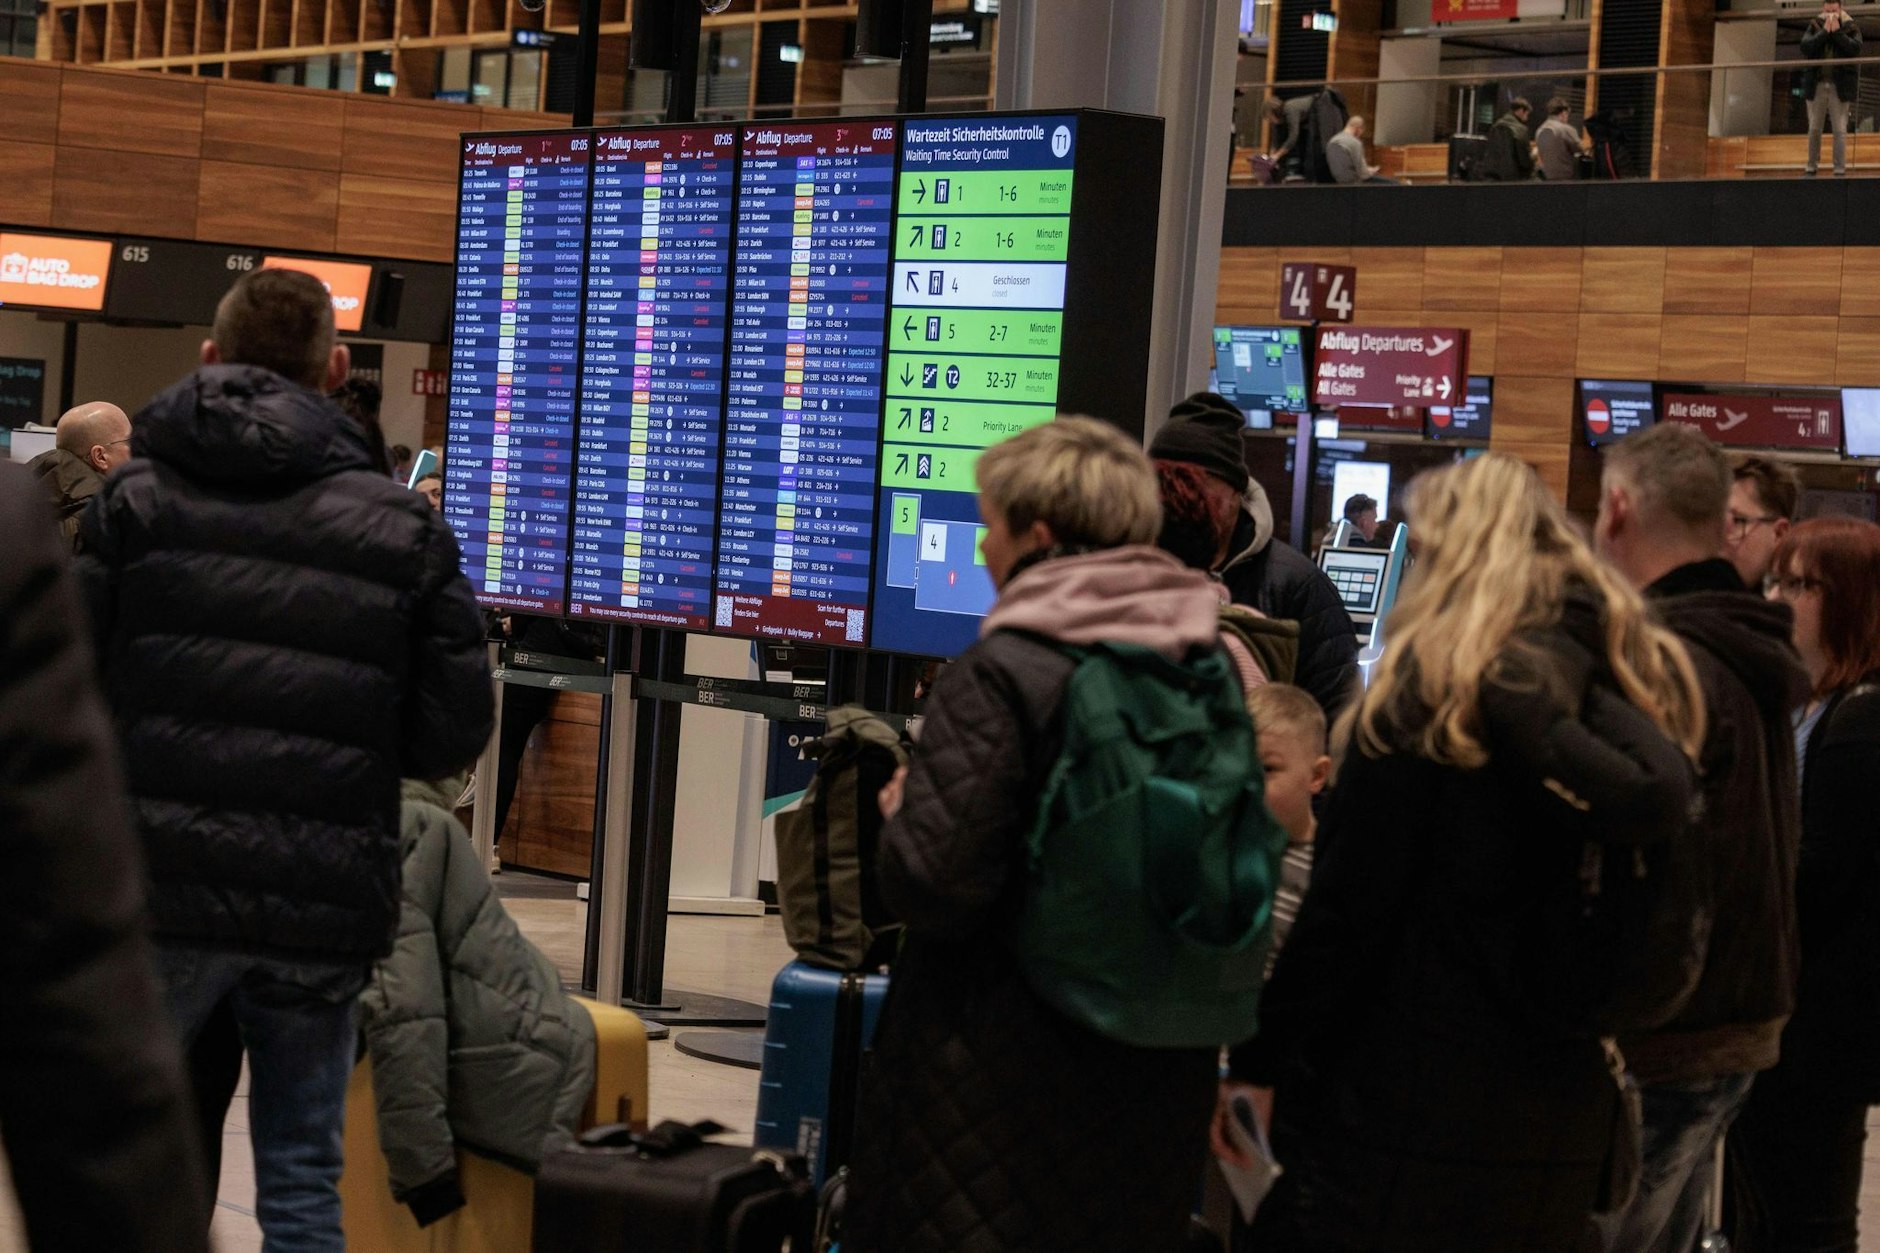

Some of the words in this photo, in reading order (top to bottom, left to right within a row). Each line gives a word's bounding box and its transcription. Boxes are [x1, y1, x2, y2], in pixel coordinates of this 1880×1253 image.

[714, 134, 733, 146] 07:05
[756, 130, 781, 146] Abflug
[784, 132, 813, 145] Departure
[837, 129, 841, 141] 3
[872, 127, 893, 140] 07:05
[907, 128, 951, 143] Wartezeit
[952, 125, 1044, 142] Sicherheitskontrolle
[571, 140, 588, 151] 07:05
[608, 136, 631, 152] Abflug
[633, 138, 660, 150] Departure
[681, 136, 686, 147] 2
[1056, 134, 1067, 150] T1
[475, 143, 496, 157] Abflug
[498, 144, 522, 156] Departure
[906, 149, 932, 164] Waiting
[934, 150, 951, 160] Time
[952, 148, 981, 163] Security
[983, 148, 1009, 160] Control
[958, 186, 963, 200] 1
[1000, 185, 1017, 201] 1-6
[1040, 182, 1067, 191] Minuten
[955, 232, 961, 247] 2
[996, 232, 1014, 248] 1-6
[1036, 229, 1063, 238] Minuten
[122, 247, 149, 262] 615
[29, 257, 70, 273] AUTO
[226, 255, 253, 271] 616
[58, 273, 100, 288] DROP
[952, 277, 959, 293] 4
[993, 276, 1030, 285] Geschlossen
[992, 289, 1008, 298] closed
[1290, 271, 1310, 316] 4
[1326, 274, 1352, 319] 4
[332, 296, 359, 310] ROP
[949, 324, 955, 339] 5
[989, 325, 1007, 341] 2-7
[1030, 323, 1056, 333] Minuten
[1320, 331, 1360, 355] Abflug
[1362, 333, 1423, 354] Departures
[1318, 362, 1337, 377] Alle
[1338, 364, 1365, 378] Gates
[948, 370, 959, 384] T2
[986, 372, 1017, 389] 32-37
[1026, 370, 1052, 381] Minuten
[1396, 374, 1420, 387] Priority
[1317, 380, 1330, 395] All
[1331, 382, 1356, 396] Gates
[1404, 388, 1420, 398] Lane
[1668, 402, 1688, 417] Alle
[1690, 404, 1717, 418] Gates
[942, 416, 949, 431] 2
[983, 421, 1006, 435] Priority
[1008, 422, 1022, 432] Lane
[1798, 422, 1806, 437] 4
[939, 462, 946, 477] 2
[902, 508, 908, 522] 5
[931, 534, 937, 549] 4
[571, 603, 582, 614] BER
[514, 652, 529, 664] BER
[697, 678, 714, 689] BER
[698, 690, 714, 704] BER
[794, 686, 810, 698] BER
[800, 704, 816, 718] BER
